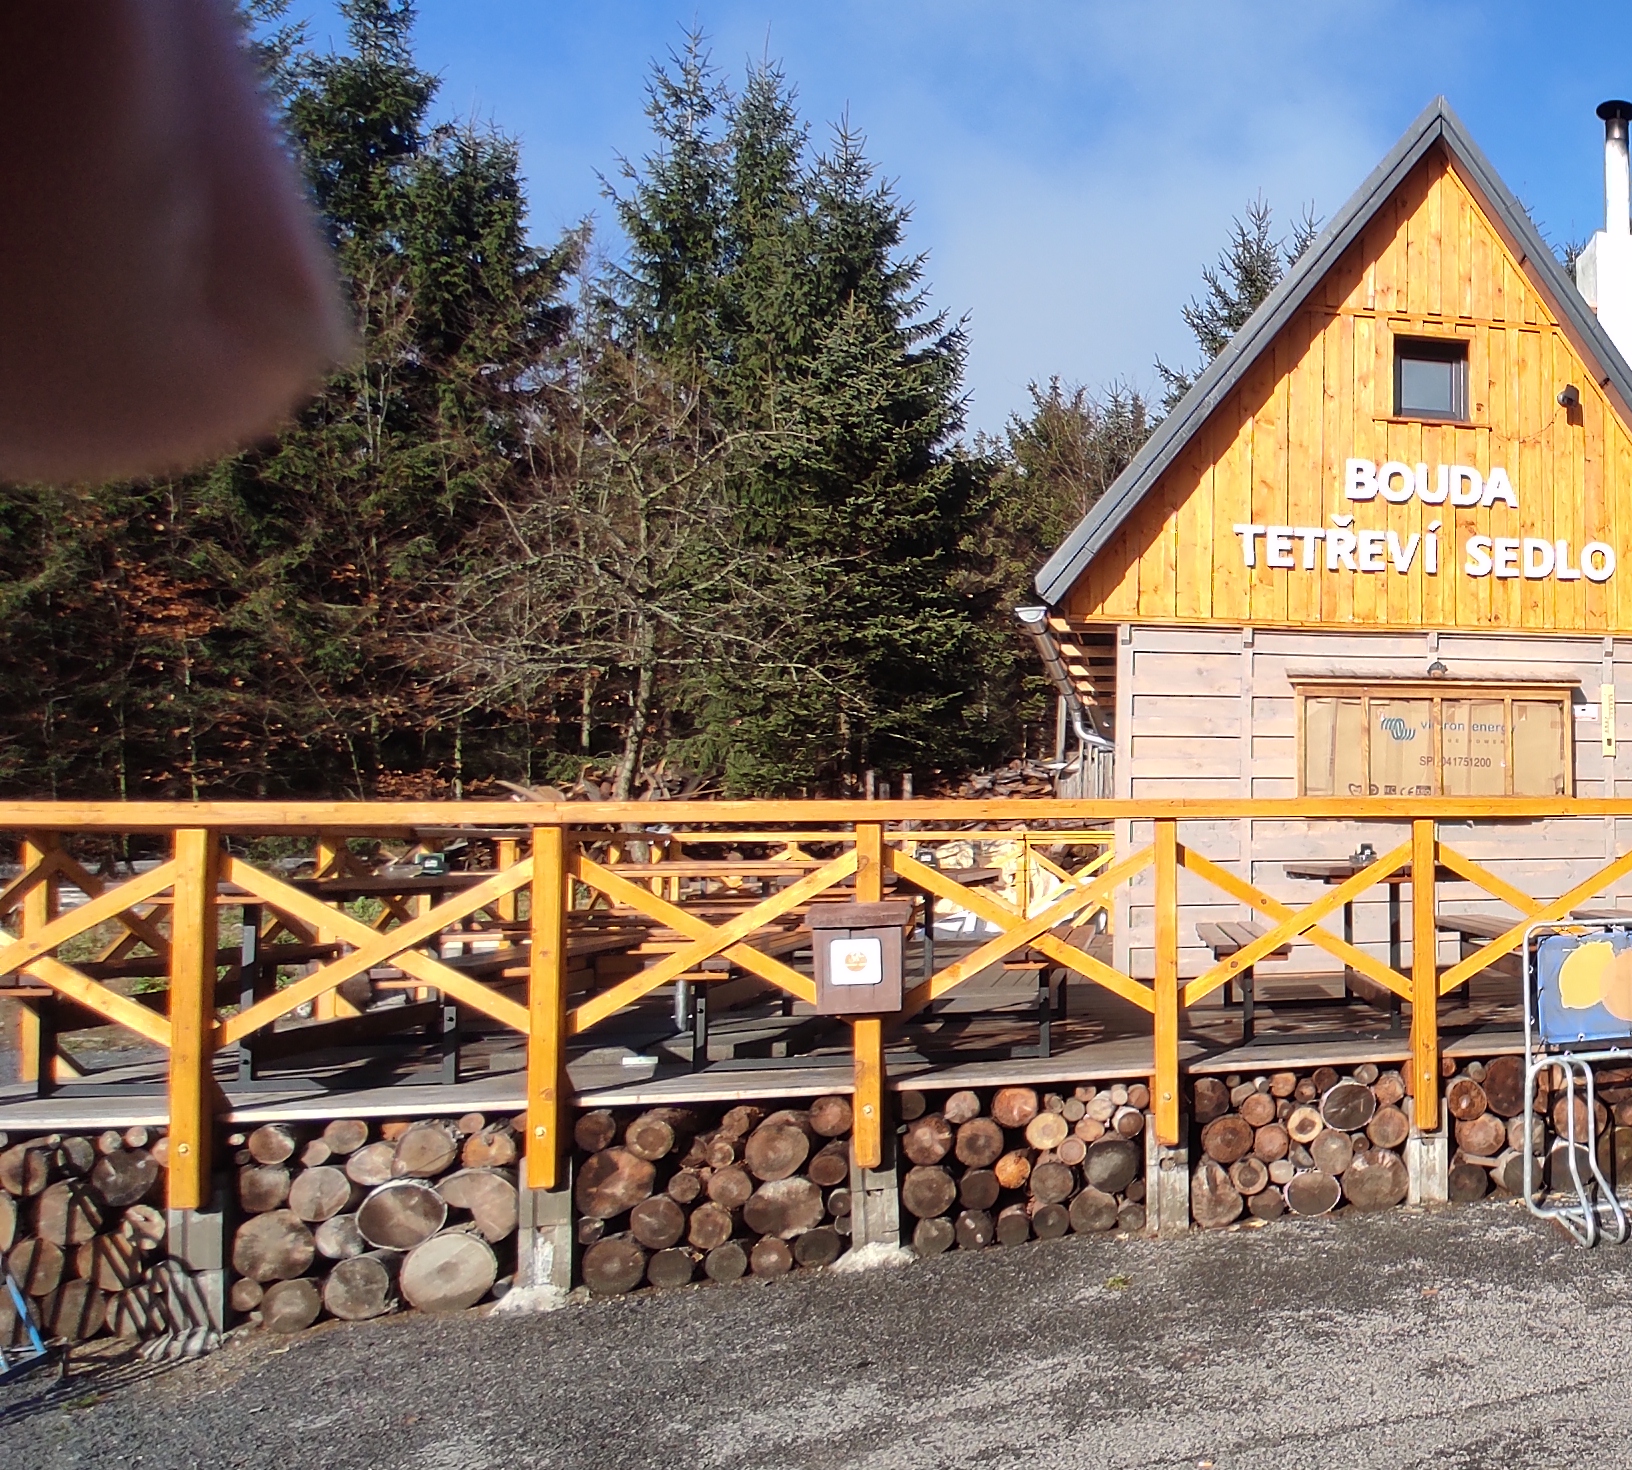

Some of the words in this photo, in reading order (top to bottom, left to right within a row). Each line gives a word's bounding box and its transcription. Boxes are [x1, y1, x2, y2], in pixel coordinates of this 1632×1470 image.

[1345, 458, 1518, 508] BOUDA
[1233, 513, 1442, 574] TETŘEVÍ
[1465, 535, 1616, 582] SEDLO
[1421, 719, 1465, 731] viron
[1472, 723, 1516, 735] energ
[1419, 756, 1491, 768] SP041751200
